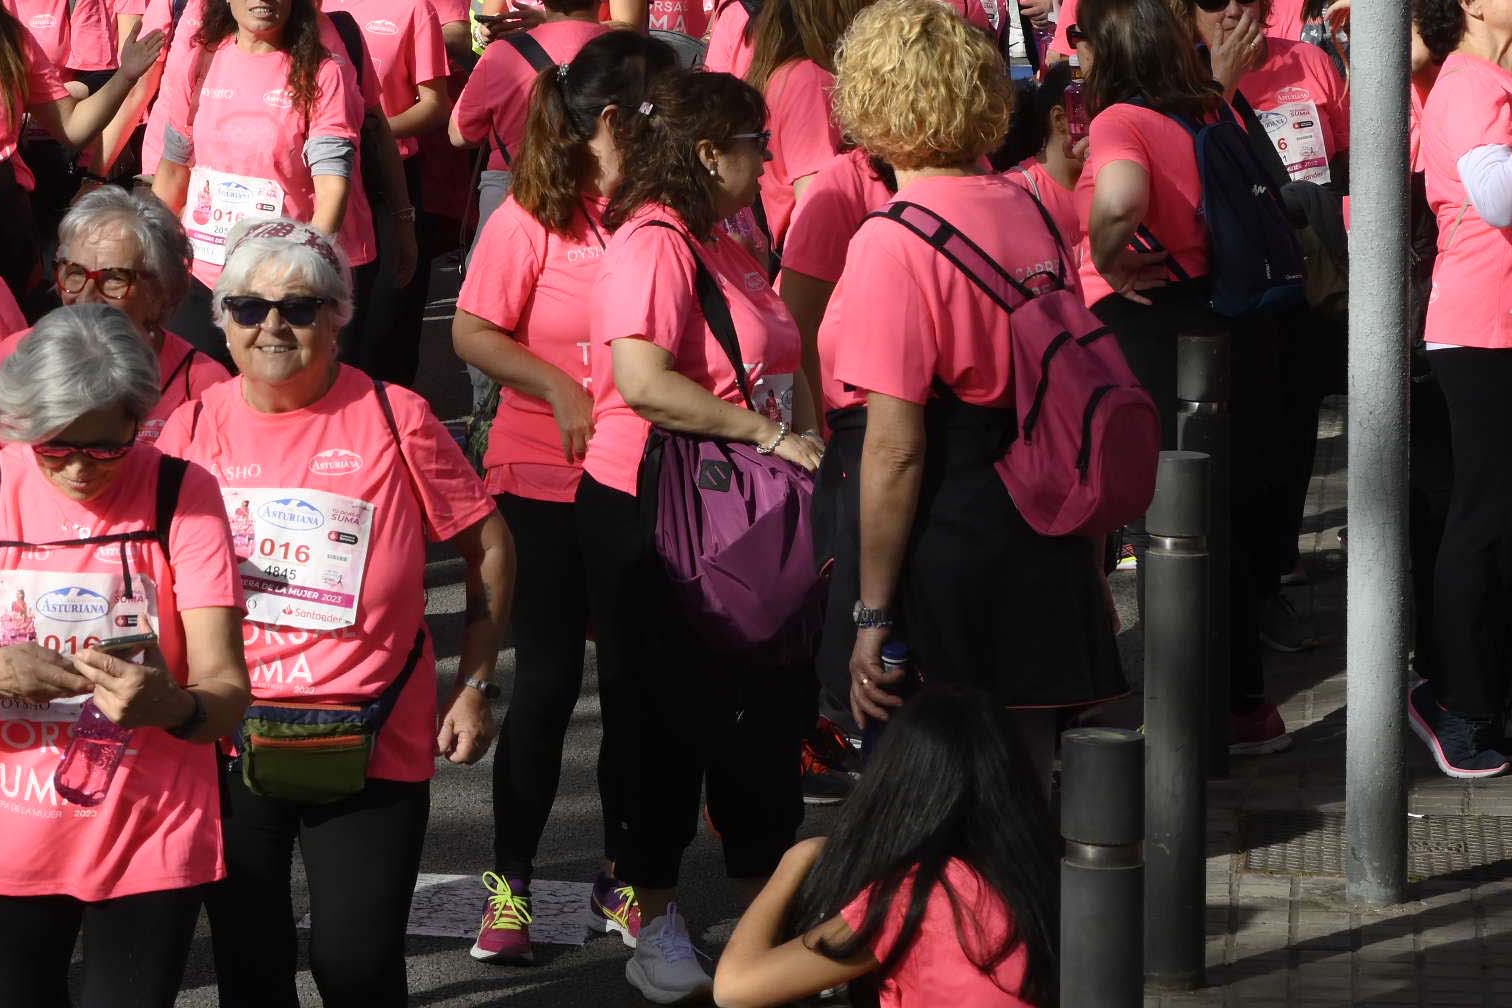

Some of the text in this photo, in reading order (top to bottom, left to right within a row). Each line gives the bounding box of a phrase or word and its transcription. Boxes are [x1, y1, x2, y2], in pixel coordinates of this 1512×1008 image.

[649, 14, 687, 33] MA
[566, 246, 607, 263] OYSH
[312, 459, 360, 473] ASTURIANA
[263, 507, 319, 527] ASTURIANA
[330, 513, 361, 525] SUMA
[259, 538, 311, 564] 016
[264, 565, 297, 580] 4845
[274, 584, 287, 593] LA
[288, 586, 319, 600] MUJER
[321, 593, 342, 603] 2023
[41, 602, 105, 615] ASTURIANA
[294, 607, 343, 624] Santander
